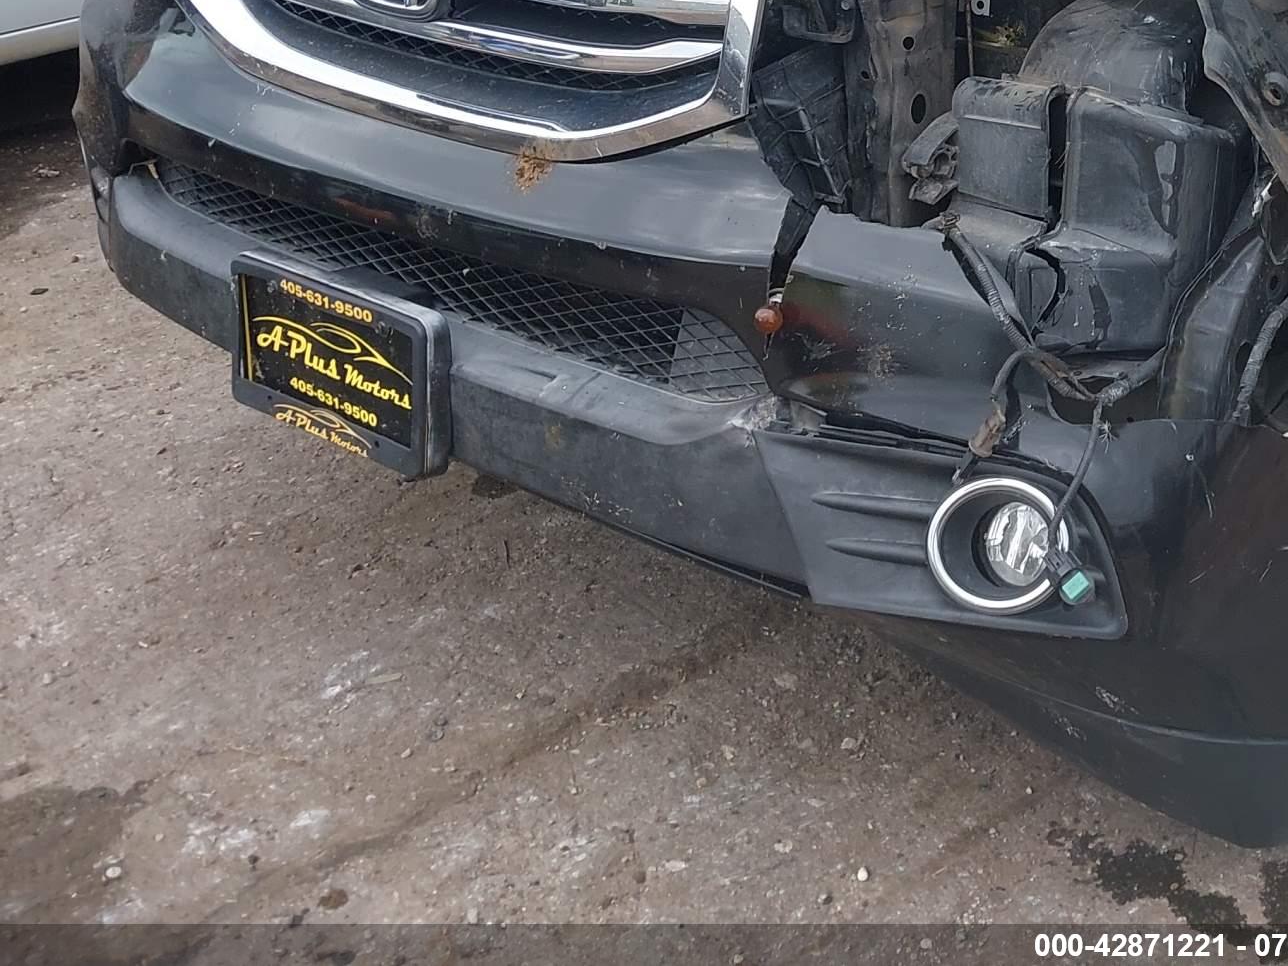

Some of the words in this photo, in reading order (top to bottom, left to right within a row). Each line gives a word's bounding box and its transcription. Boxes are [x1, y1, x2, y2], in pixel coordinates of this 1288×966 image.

[280, 279, 372, 323] 405-631-9500
[290, 377, 378, 428] 405-631-9500
[344, 363, 412, 410] Motors
[330, 431, 368, 458] Motors
